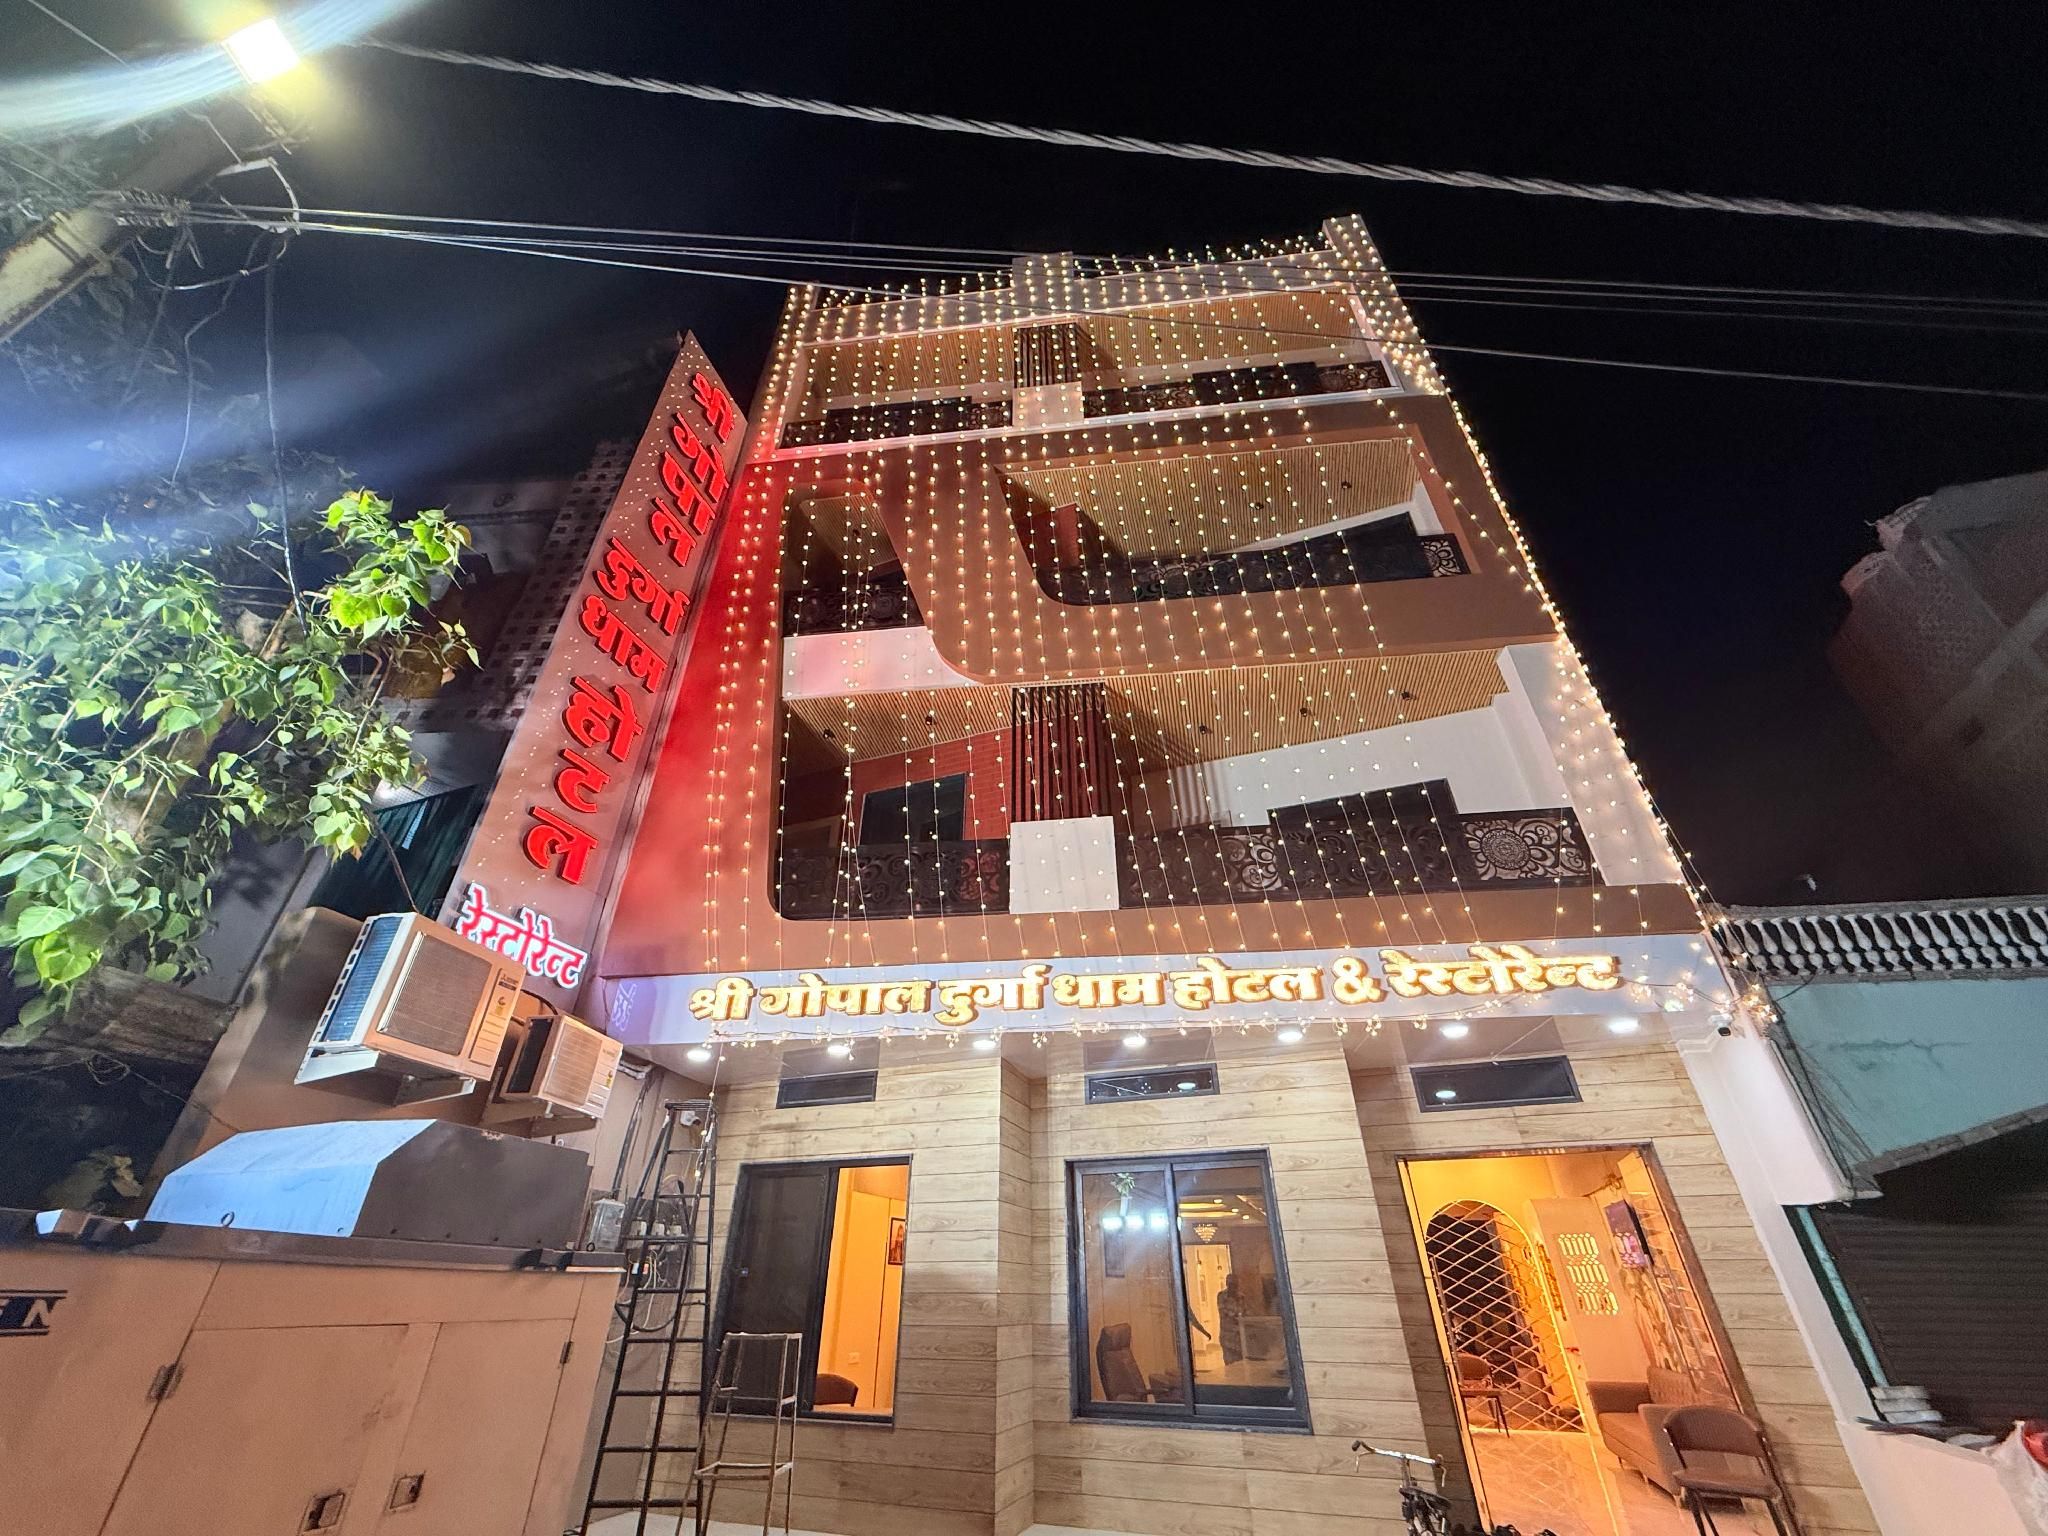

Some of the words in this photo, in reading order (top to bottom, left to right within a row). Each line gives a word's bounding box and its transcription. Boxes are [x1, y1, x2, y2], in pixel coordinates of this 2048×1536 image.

[579, 594, 669, 694] धाम
[523, 674, 643, 885] होटल
[689, 976, 757, 1021] श्री
[758, 972, 936, 1018] गोपाल
[1051, 973, 1169, 1009] धाम
[1168, 956, 1324, 1011] होटल
[1331, 956, 1389, 1005] &
